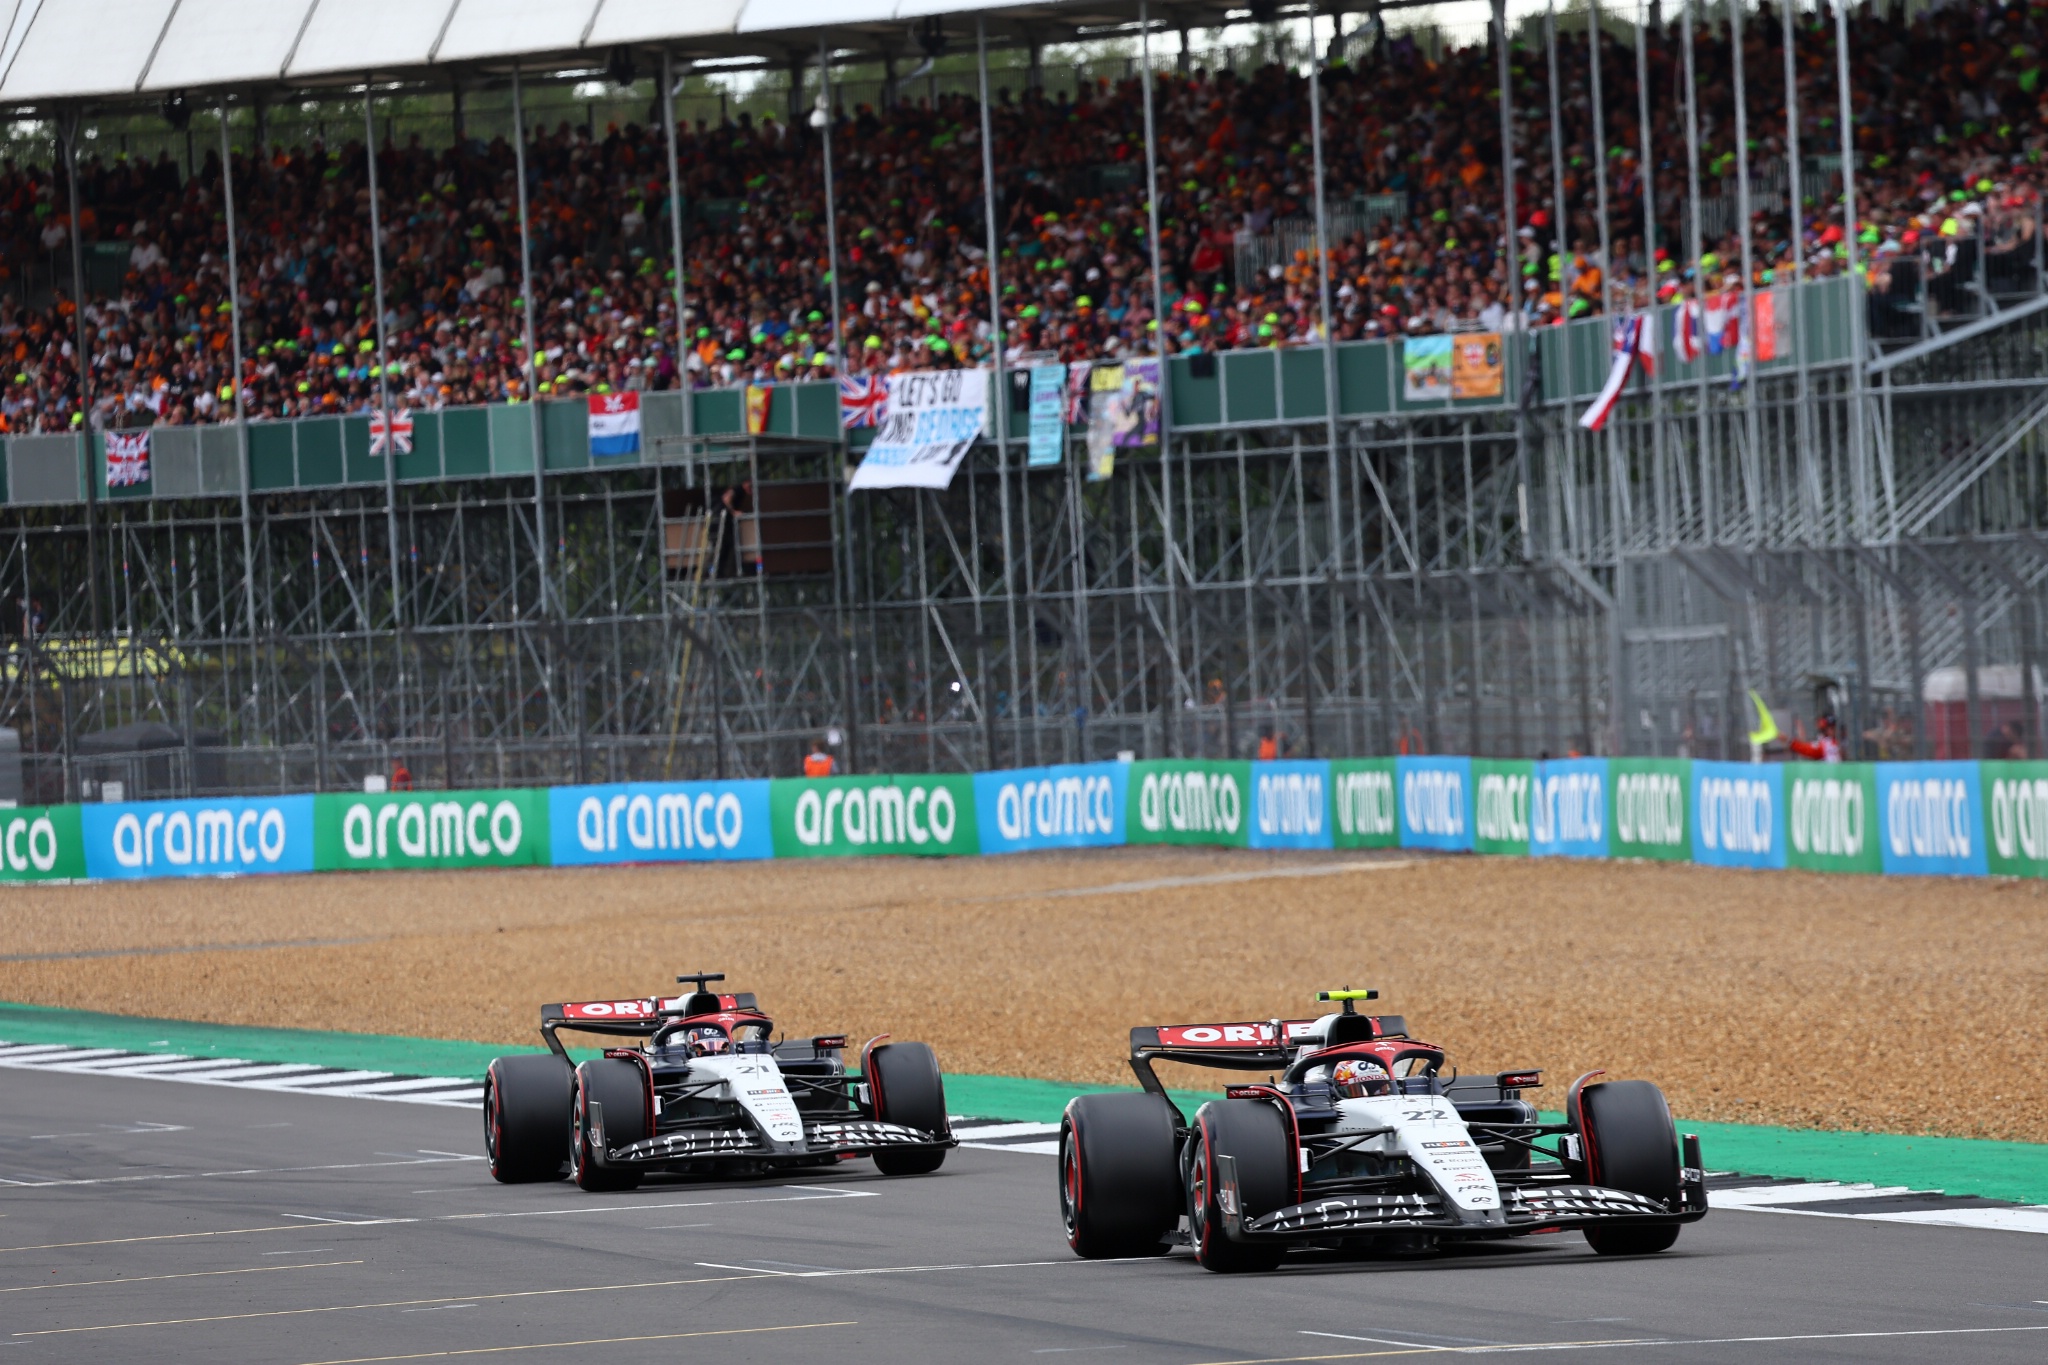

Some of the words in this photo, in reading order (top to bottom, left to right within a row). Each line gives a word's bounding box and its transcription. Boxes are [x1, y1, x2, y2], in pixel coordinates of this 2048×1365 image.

[343, 800, 522, 858] aramco
[577, 793, 742, 851] aramco
[795, 786, 955, 845] aramco
[997, 775, 1112, 840] aramco
[1140, 771, 1240, 833] aramco
[0, 817, 57, 872] co
[113, 808, 286, 867] aramco
[736, 1065, 770, 1074] 21
[1354, 1074, 1387, 1083] HONDA
[1402, 1109, 1449, 1121] 22
